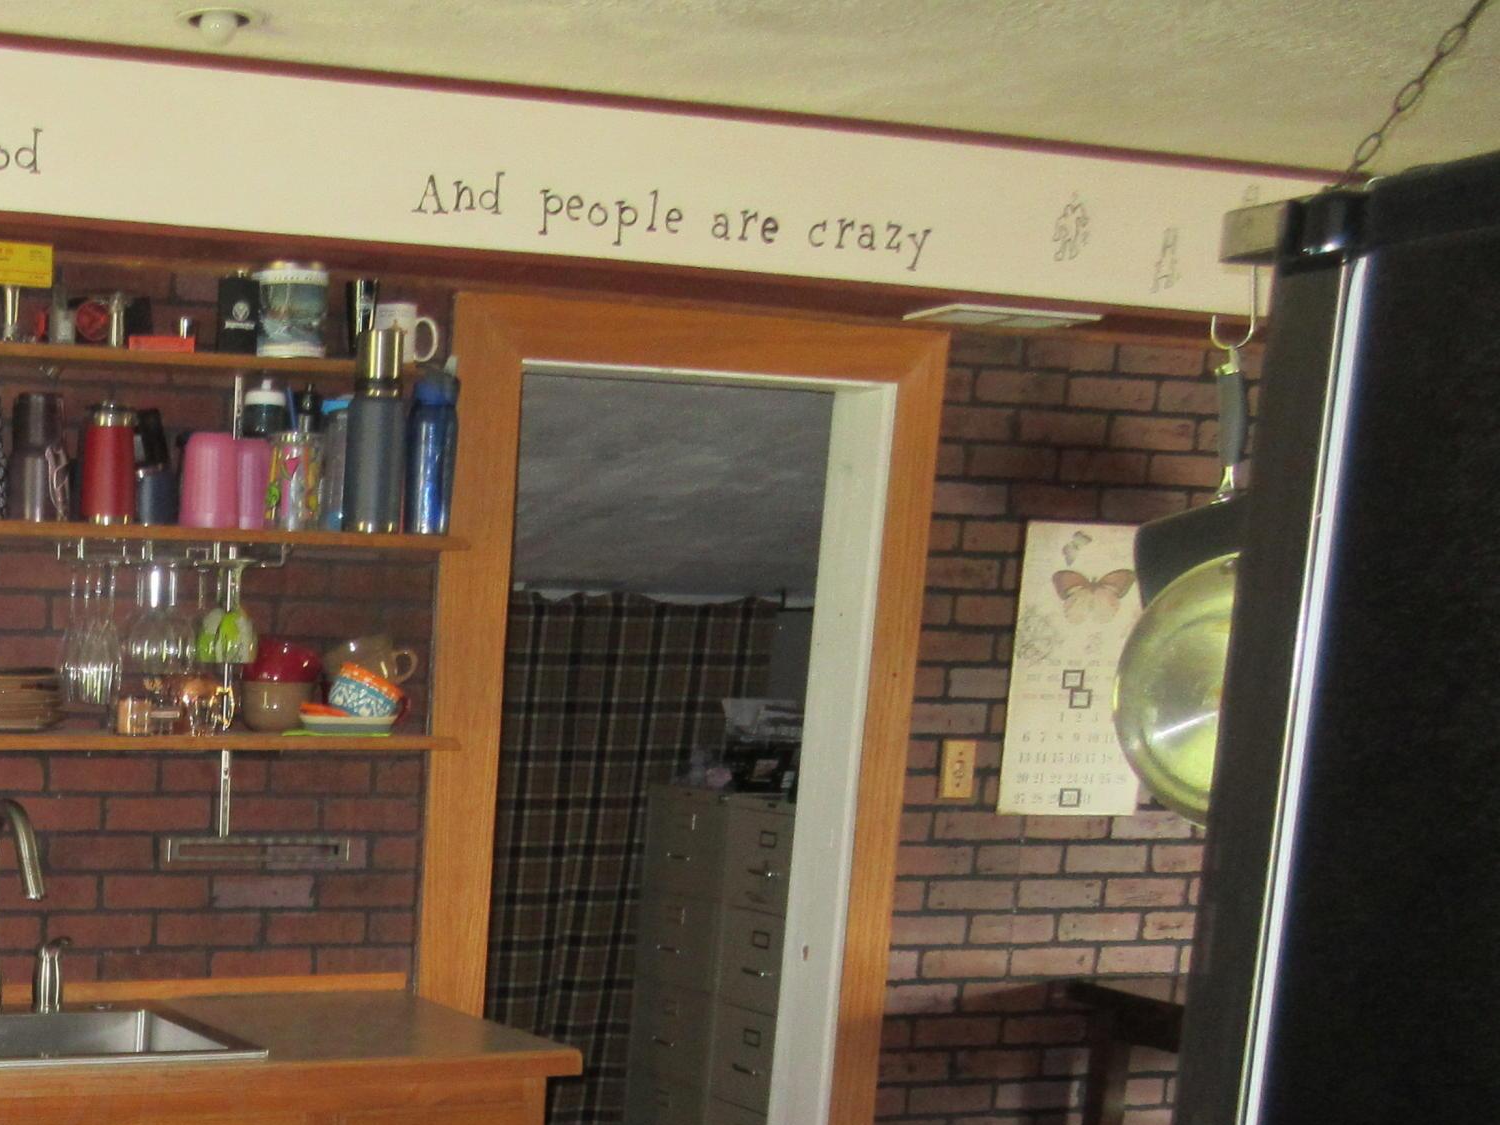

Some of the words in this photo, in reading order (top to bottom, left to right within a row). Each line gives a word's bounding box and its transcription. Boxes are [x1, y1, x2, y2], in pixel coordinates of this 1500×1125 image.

[411, 171, 506, 215] And
[538, 189, 685, 245] people
[711, 207, 780, 244] are
[808, 215, 934, 271] crazy
